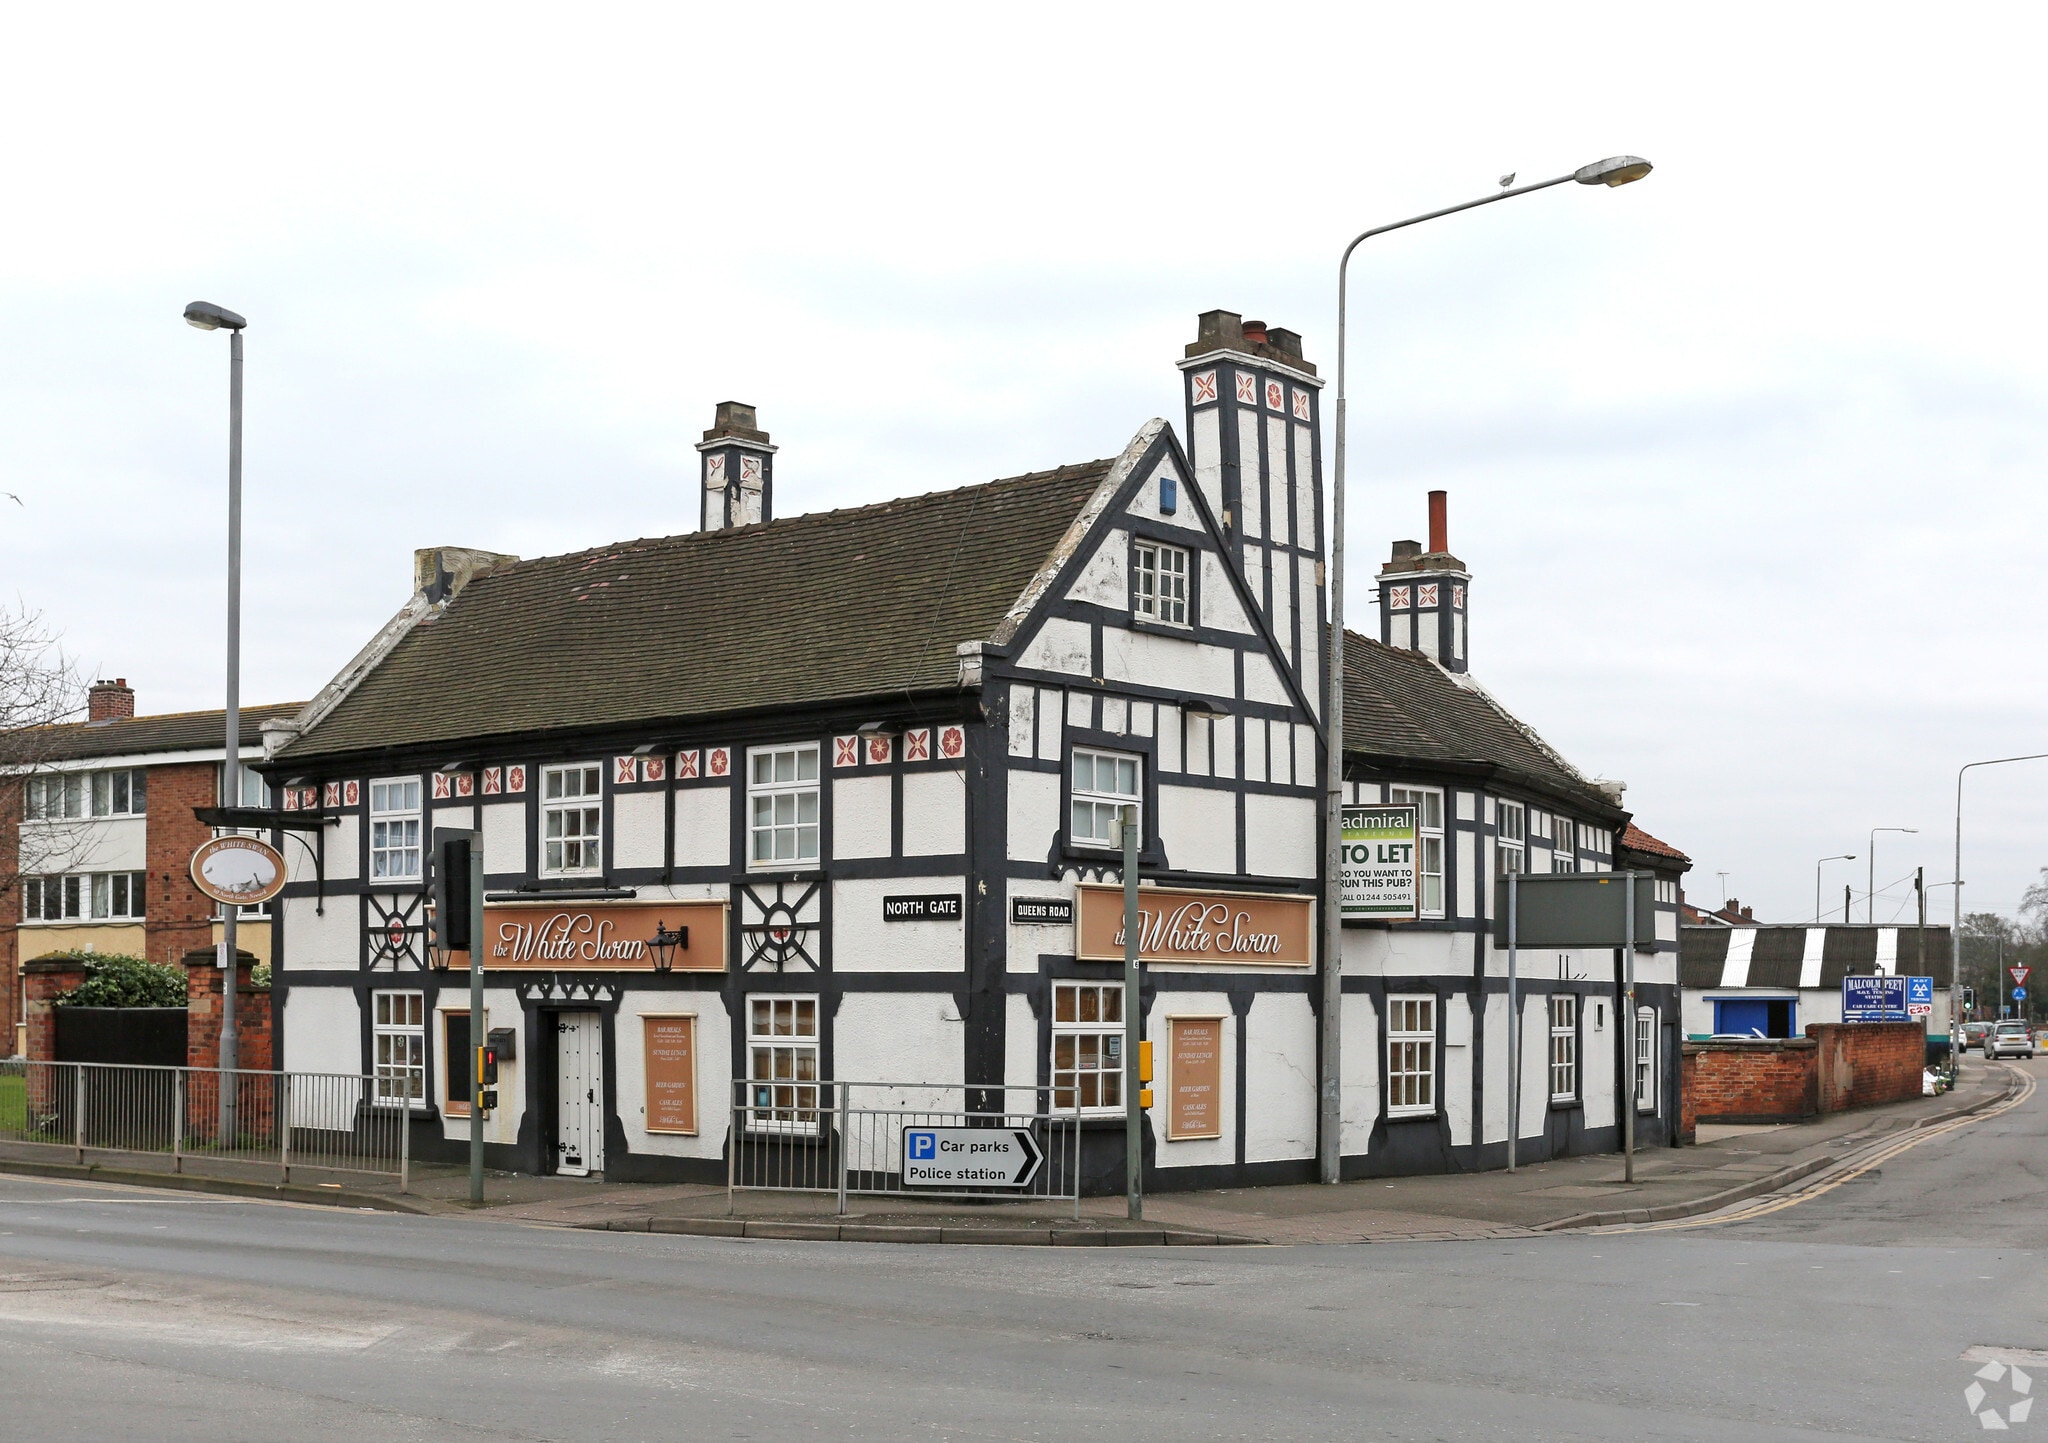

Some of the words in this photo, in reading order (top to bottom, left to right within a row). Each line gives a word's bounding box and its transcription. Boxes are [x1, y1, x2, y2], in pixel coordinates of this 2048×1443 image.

[1341, 812, 1410, 829] admiral
[209, 846, 219, 854] the
[220, 841, 246, 849] WHITE
[246, 842, 269, 856] SWAN
[1341, 844, 1369, 864] TO
[1377, 844, 1412, 863] LET
[1386, 879, 1412, 887] PUB?
[249, 890, 267, 899] Newark
[886, 901, 924, 915] NORTH
[929, 901, 957, 914] GATE
[1018, 904, 1047, 917] QUEENS
[1049, 906, 1069, 917] ROAD
[1114, 930, 1125, 946] th
[1122, 902, 1228, 952] White
[1216, 912, 1282, 954] Swan
[500, 913, 592, 962] White
[580, 920, 646, 960] Swan
[493, 942, 508, 958] the
[1848, 979, 1881, 991] MALCOLM
[1884, 979, 1902, 992] PEET
[915, 1136, 932, 1157] P
[940, 1140, 965, 1152] Car
[970, 1141, 1009, 1154] parks
[910, 1167, 952, 1179] Police
[957, 1168, 1006, 1179] station
